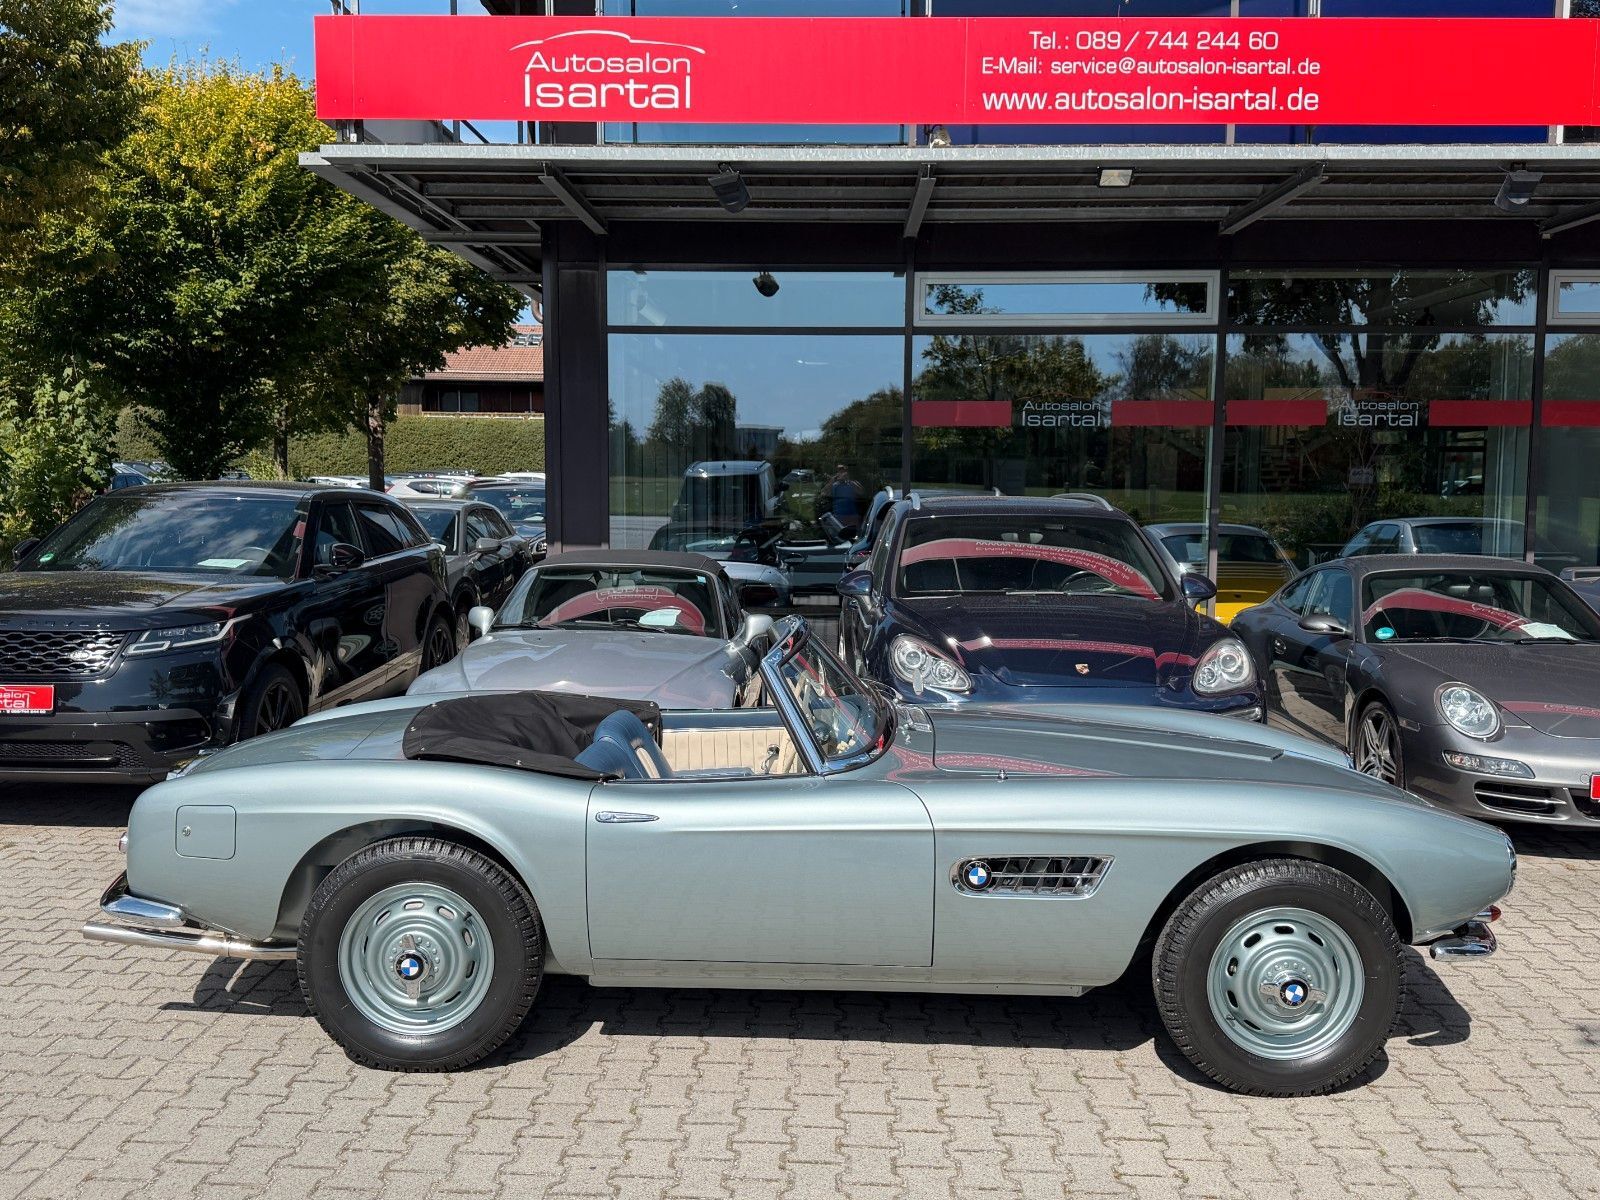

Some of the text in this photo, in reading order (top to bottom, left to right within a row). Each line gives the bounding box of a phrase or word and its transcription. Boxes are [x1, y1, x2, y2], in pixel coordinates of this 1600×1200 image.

[1028, 30, 1069, 50] Tel.:
[1076, 30, 1121, 50] 089
[1145, 31, 1188, 50] 744
[1196, 31, 1241, 50] 244
[1248, 31, 1279, 50] 60
[524, 51, 691, 74] Autosalon
[982, 56, 1321, 75] E-Mail: service@autosalon-isartal.de
[524, 73, 691, 109] Isartal
[982, 85, 1319, 111] www.autosalon-isartal.de
[1022, 400, 1101, 411] Autosalon
[1335, 400, 1419, 411] Autosalon
[1021, 410, 1101, 427] Isartal
[1337, 410, 1419, 427] Isartal
